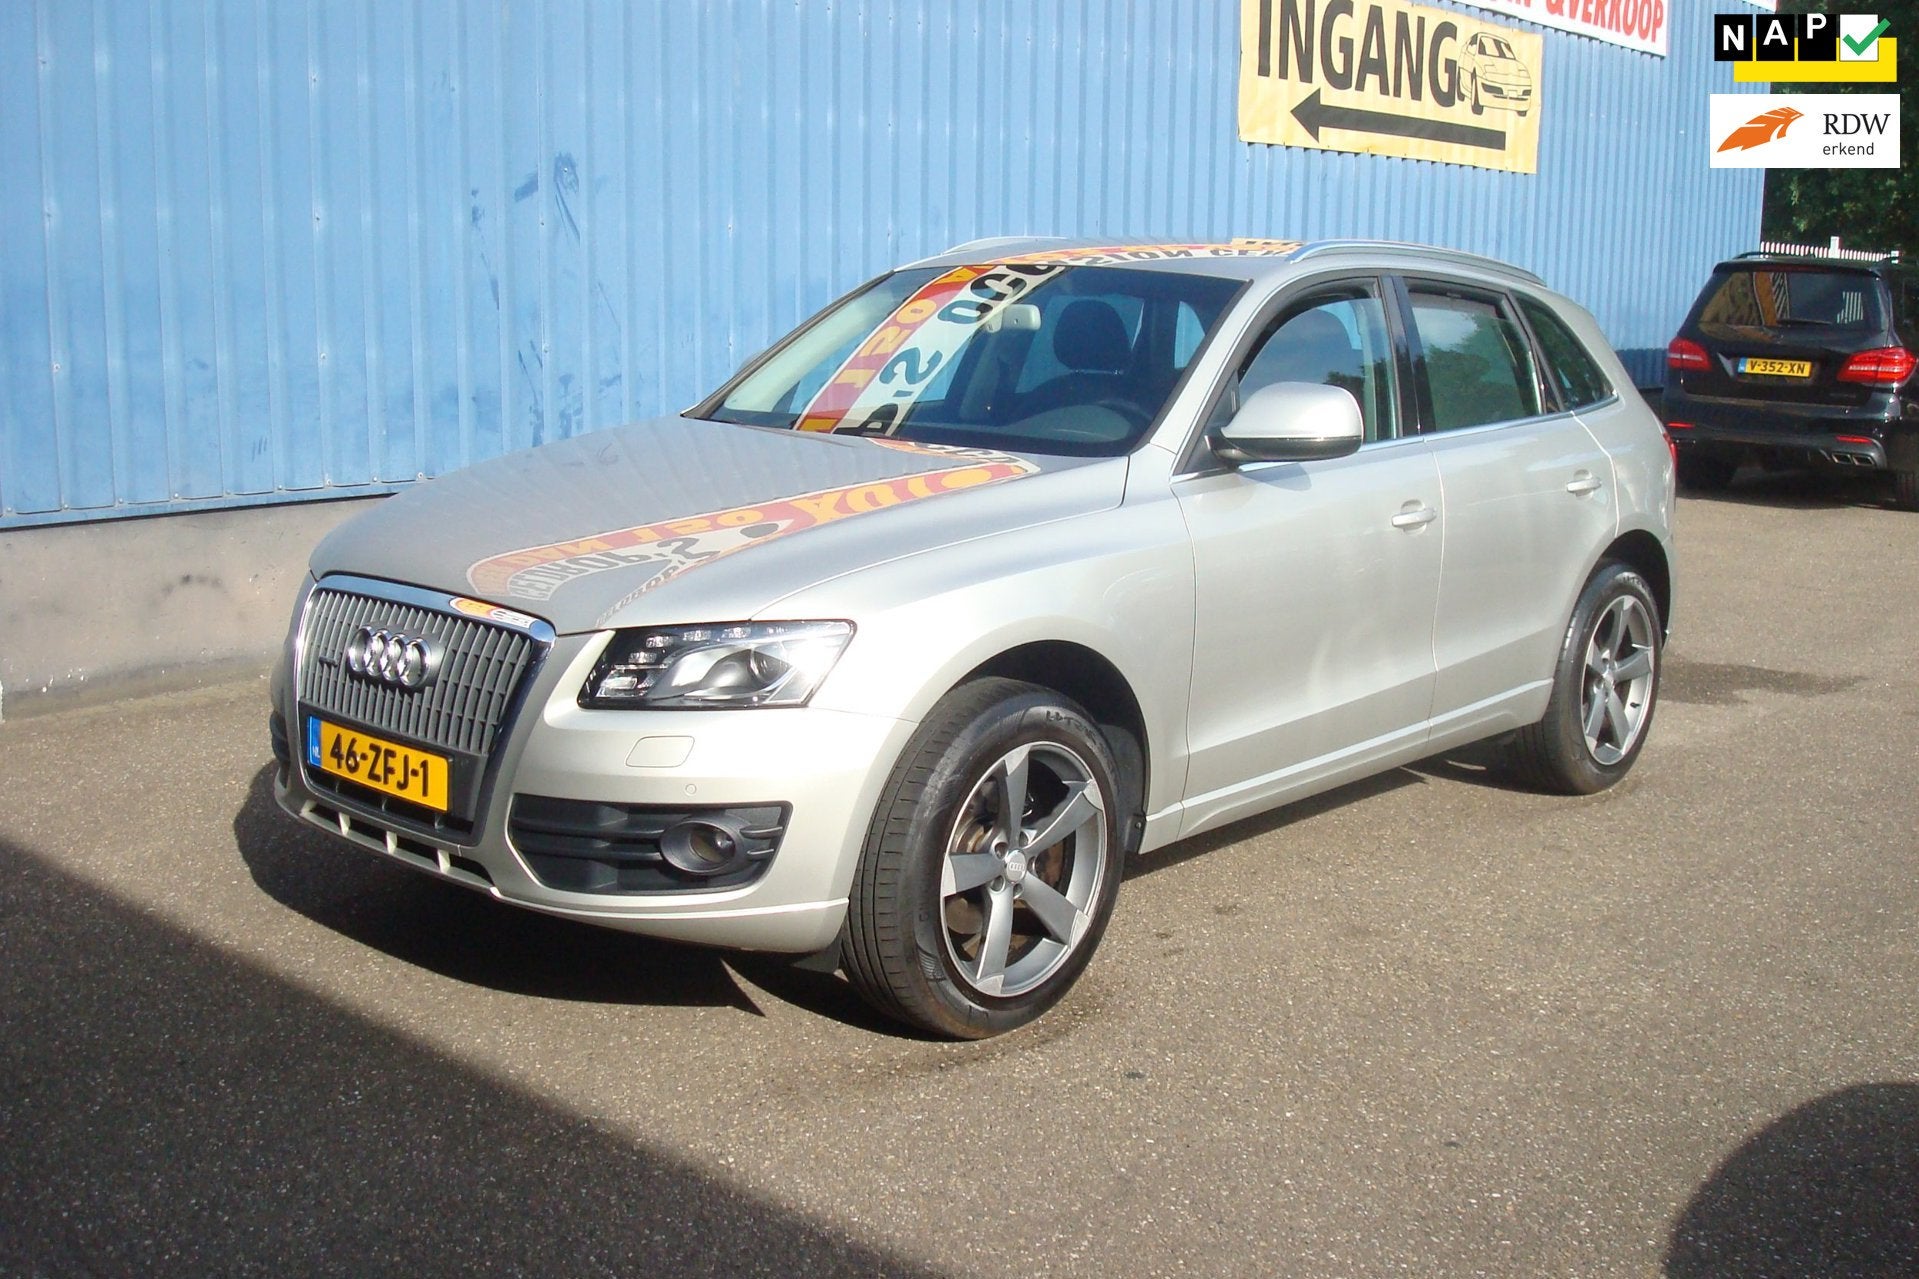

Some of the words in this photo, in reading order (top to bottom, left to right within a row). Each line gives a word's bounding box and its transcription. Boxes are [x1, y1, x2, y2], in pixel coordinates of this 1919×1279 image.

[1258, 0, 1457, 107] INGANG
[1750, 360, 1805, 374] V-352-XN
[330, 733, 428, 797] 46-ZFJ-1
